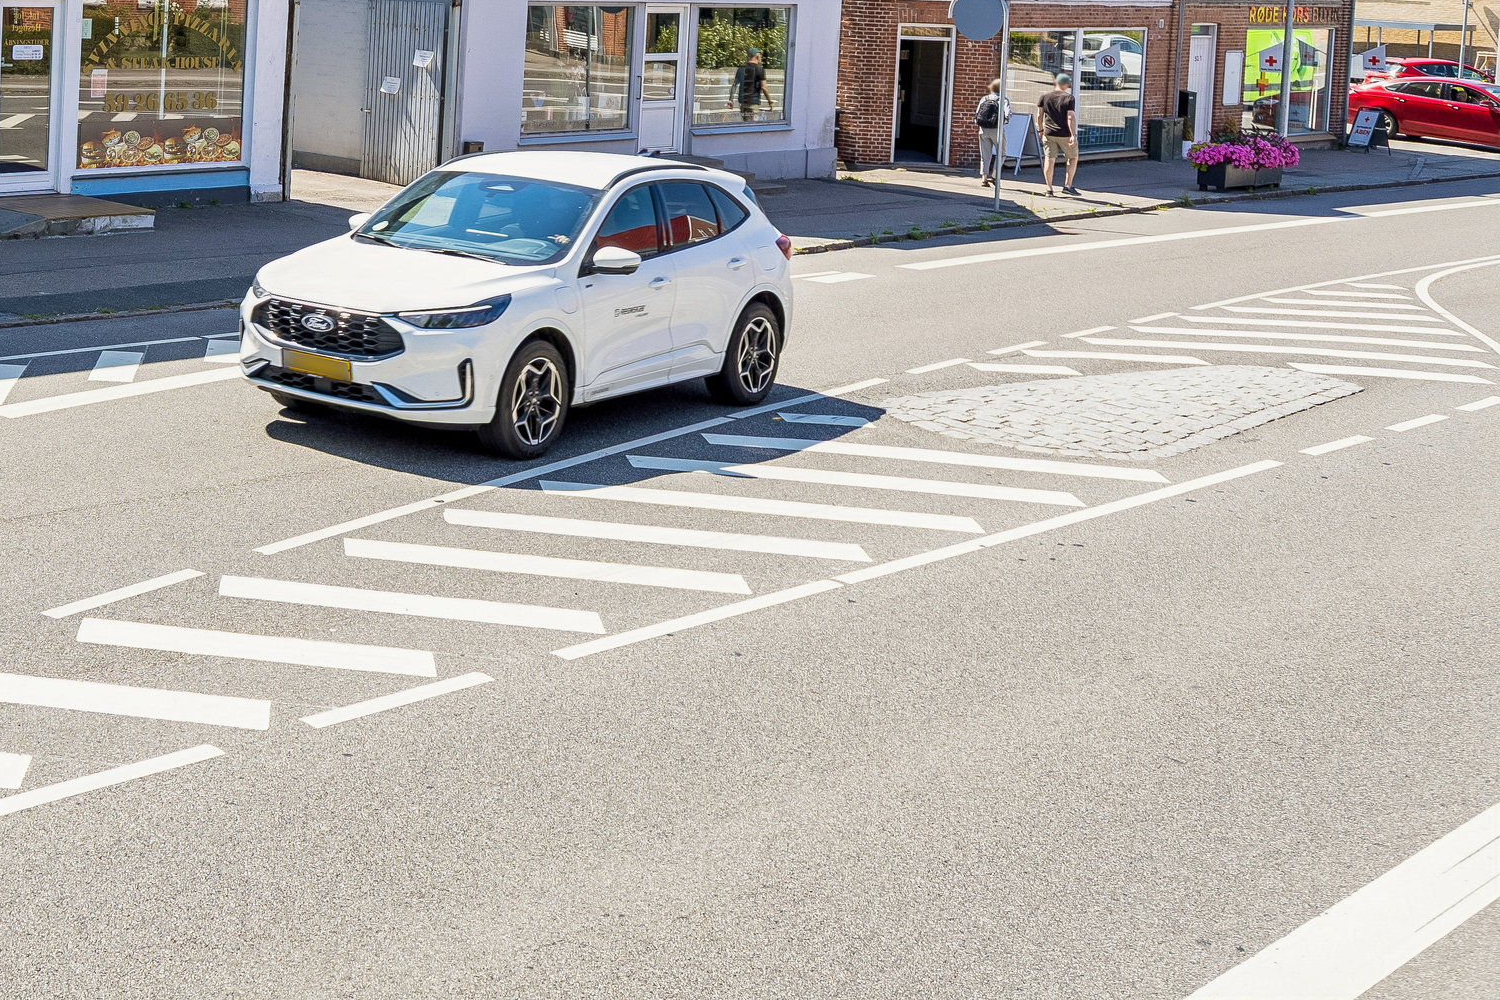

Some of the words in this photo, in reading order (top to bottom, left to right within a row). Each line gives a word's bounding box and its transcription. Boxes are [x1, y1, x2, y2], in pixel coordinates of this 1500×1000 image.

[1249, 5, 1280, 24] RØDE
[133, 93, 160, 111] 26
[163, 91, 189, 110] 65
[192, 91, 218, 109] 36
